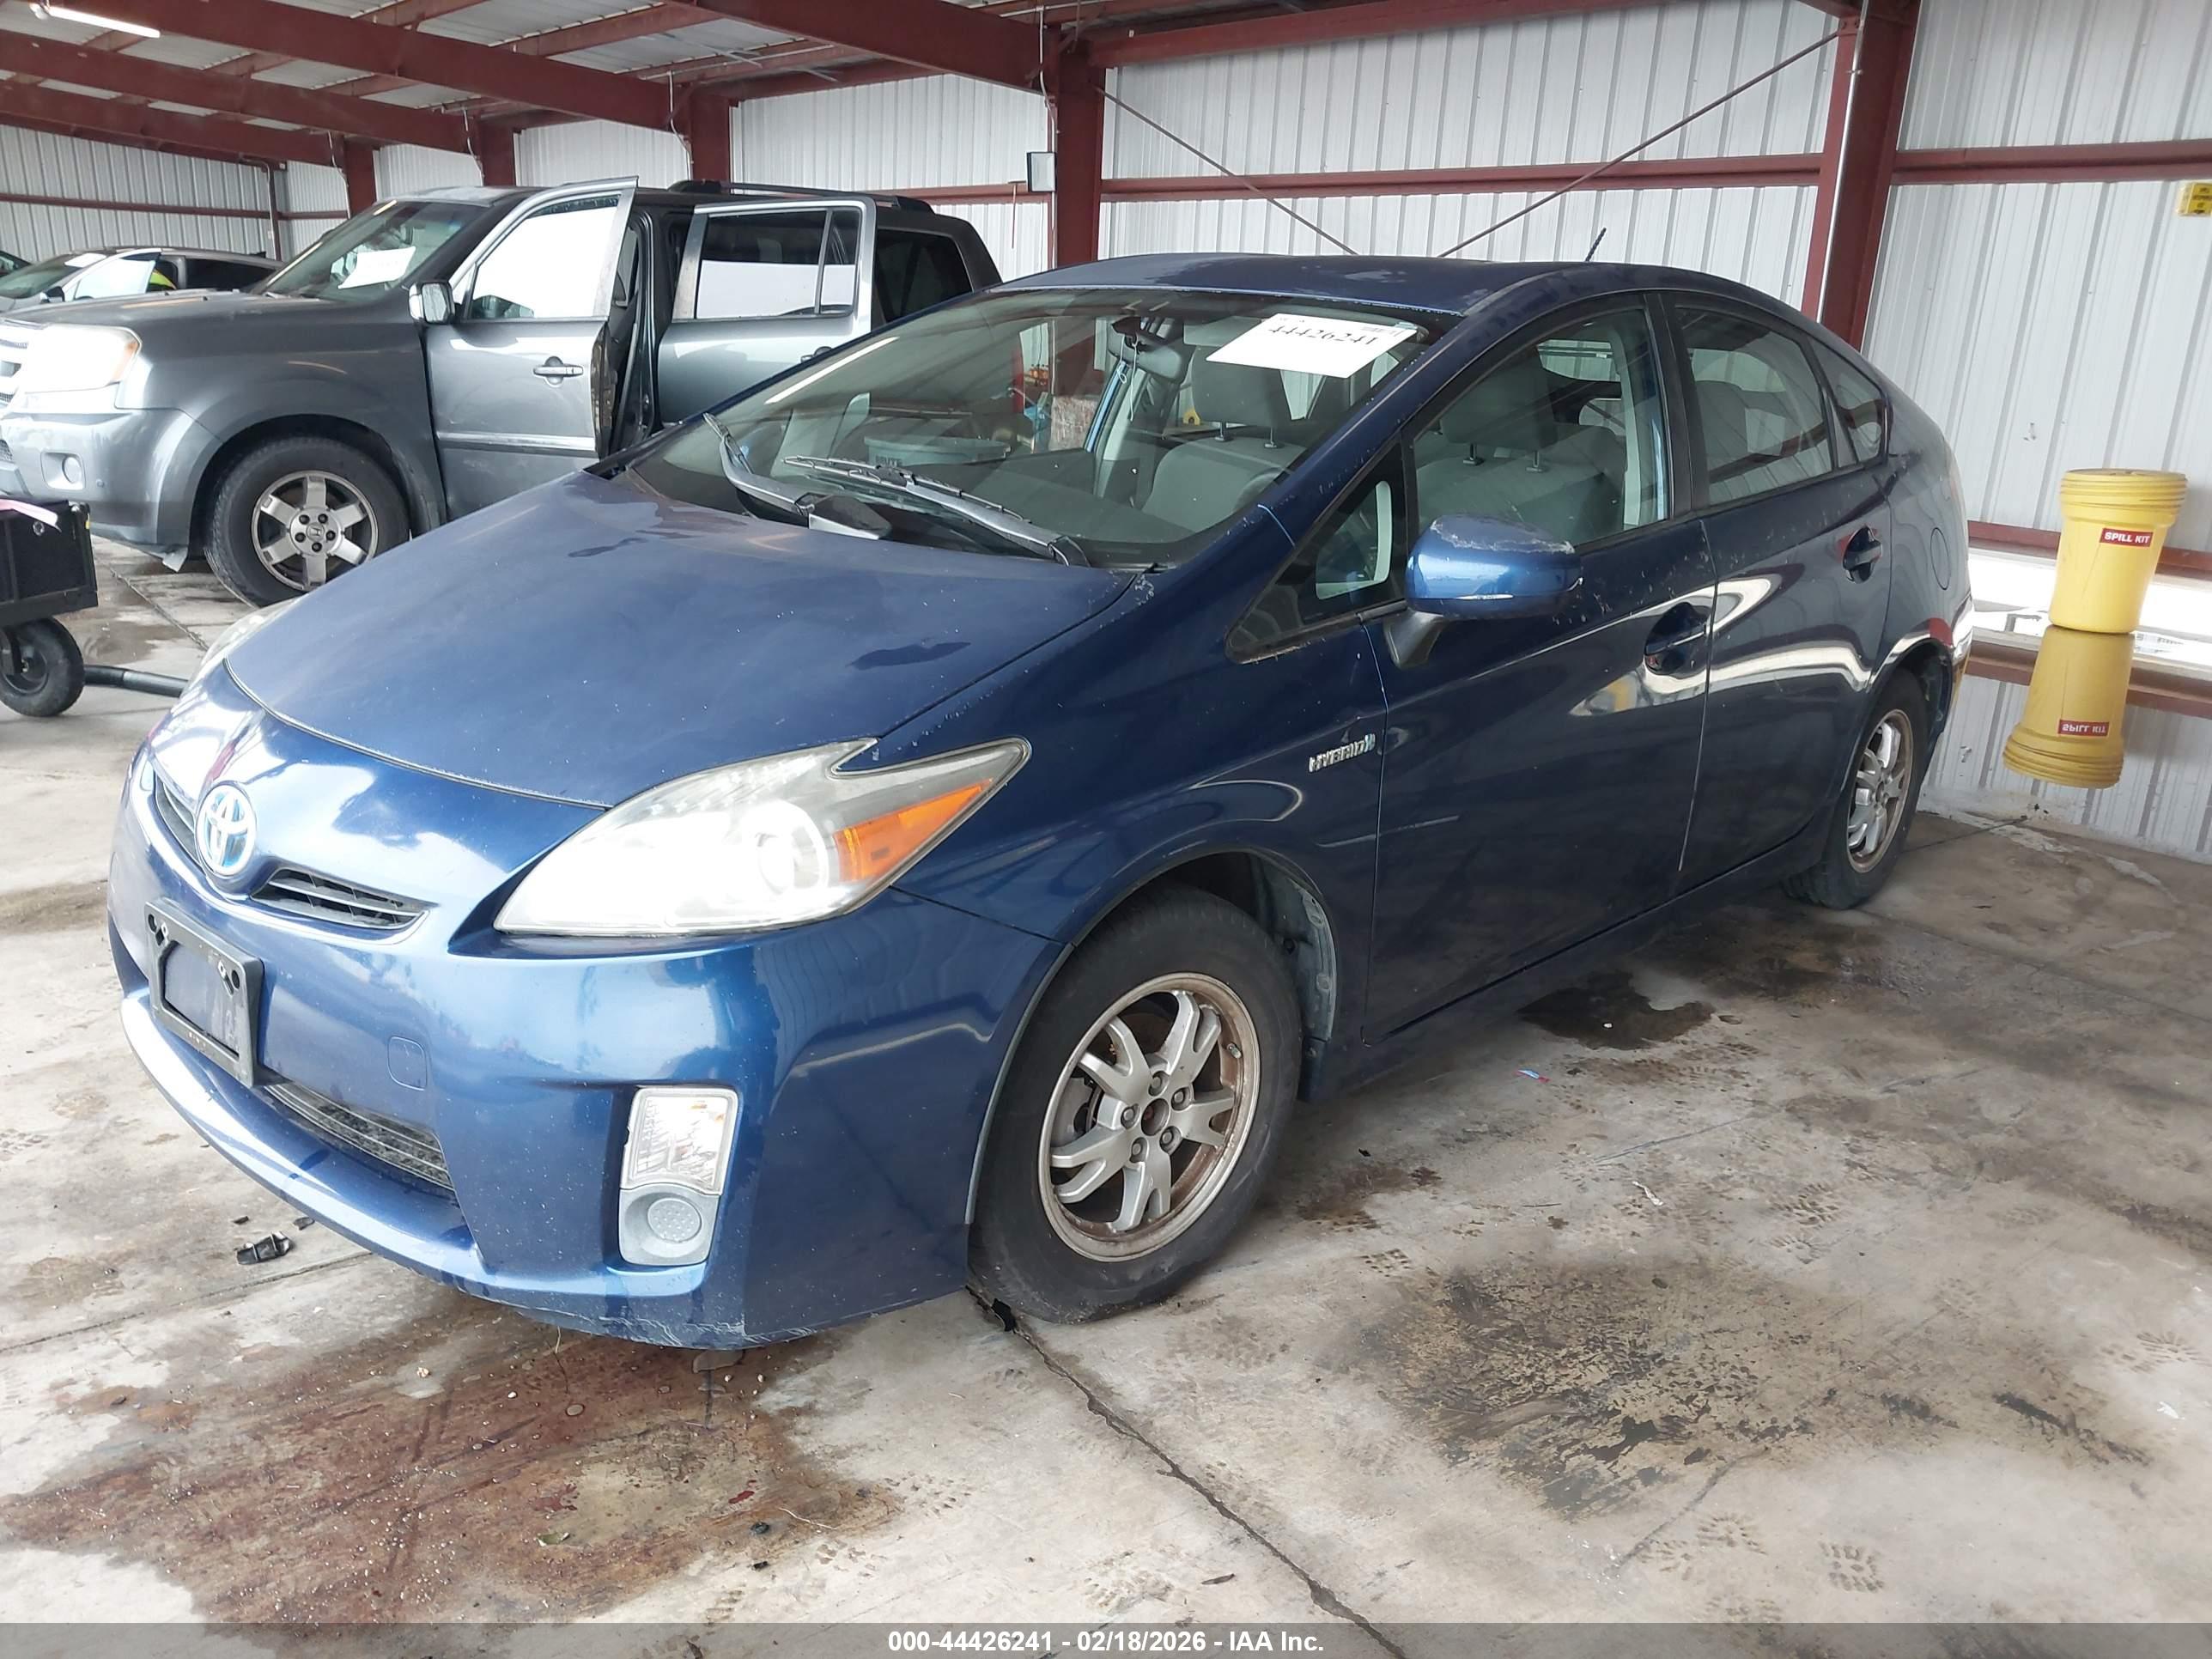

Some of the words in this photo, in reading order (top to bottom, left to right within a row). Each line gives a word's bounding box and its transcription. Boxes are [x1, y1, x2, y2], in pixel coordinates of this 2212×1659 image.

[1268, 325, 1379, 344] 44426241
[2104, 532, 2132, 543] SPILL
[2135, 535, 2150, 544] KIT
[1309, 740, 1365, 773] HYBRID
